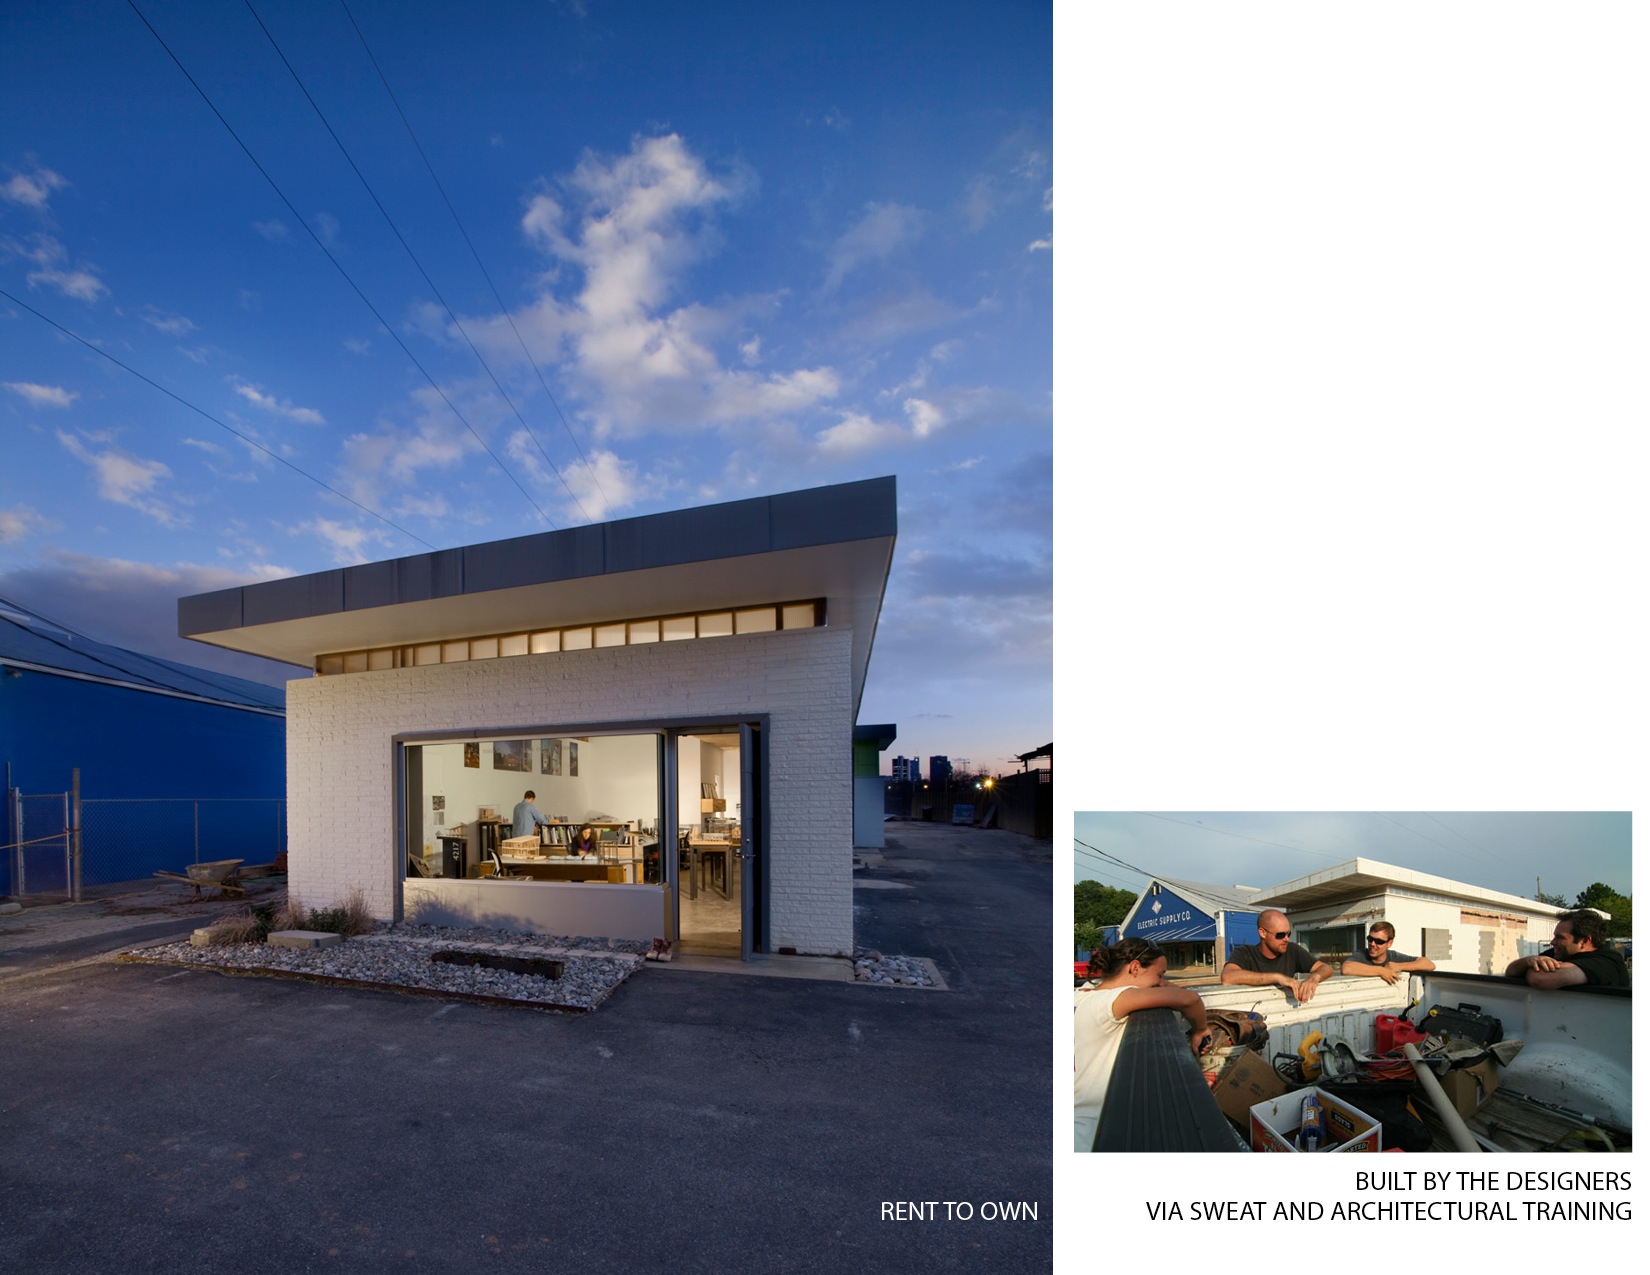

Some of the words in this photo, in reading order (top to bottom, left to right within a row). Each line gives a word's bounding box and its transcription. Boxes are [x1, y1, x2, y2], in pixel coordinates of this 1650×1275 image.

[452, 842, 460, 861] 4217
[1137, 919, 1158, 930] ELECTRIC
[1159, 913, 1181, 925] SUPPLY
